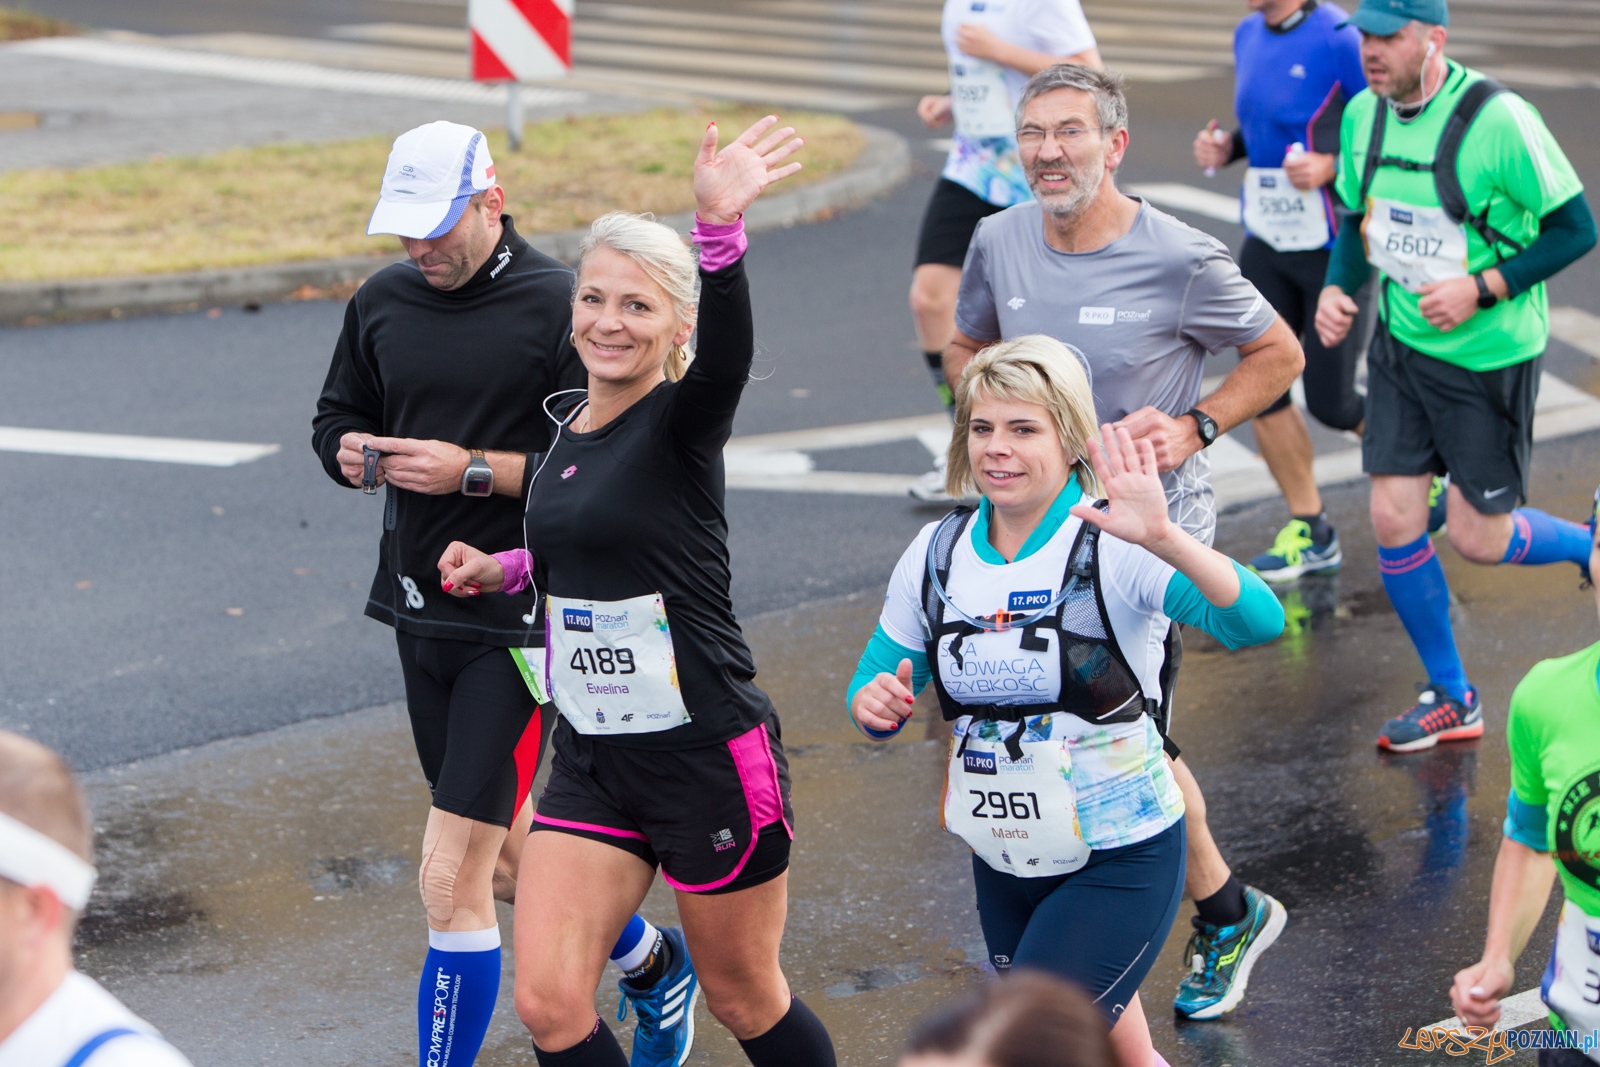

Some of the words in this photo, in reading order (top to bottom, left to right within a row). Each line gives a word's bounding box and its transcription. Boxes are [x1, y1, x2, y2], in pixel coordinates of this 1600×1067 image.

[1386, 232, 1442, 257] 6607
[570, 647, 636, 675] 4189
[586, 682, 629, 695] Ewelina
[944, 674, 1049, 694] SZYBKOŚĆ
[969, 789, 1041, 820] 2961
[991, 827, 1029, 839] Marta
[715, 841, 736, 852] RUN
